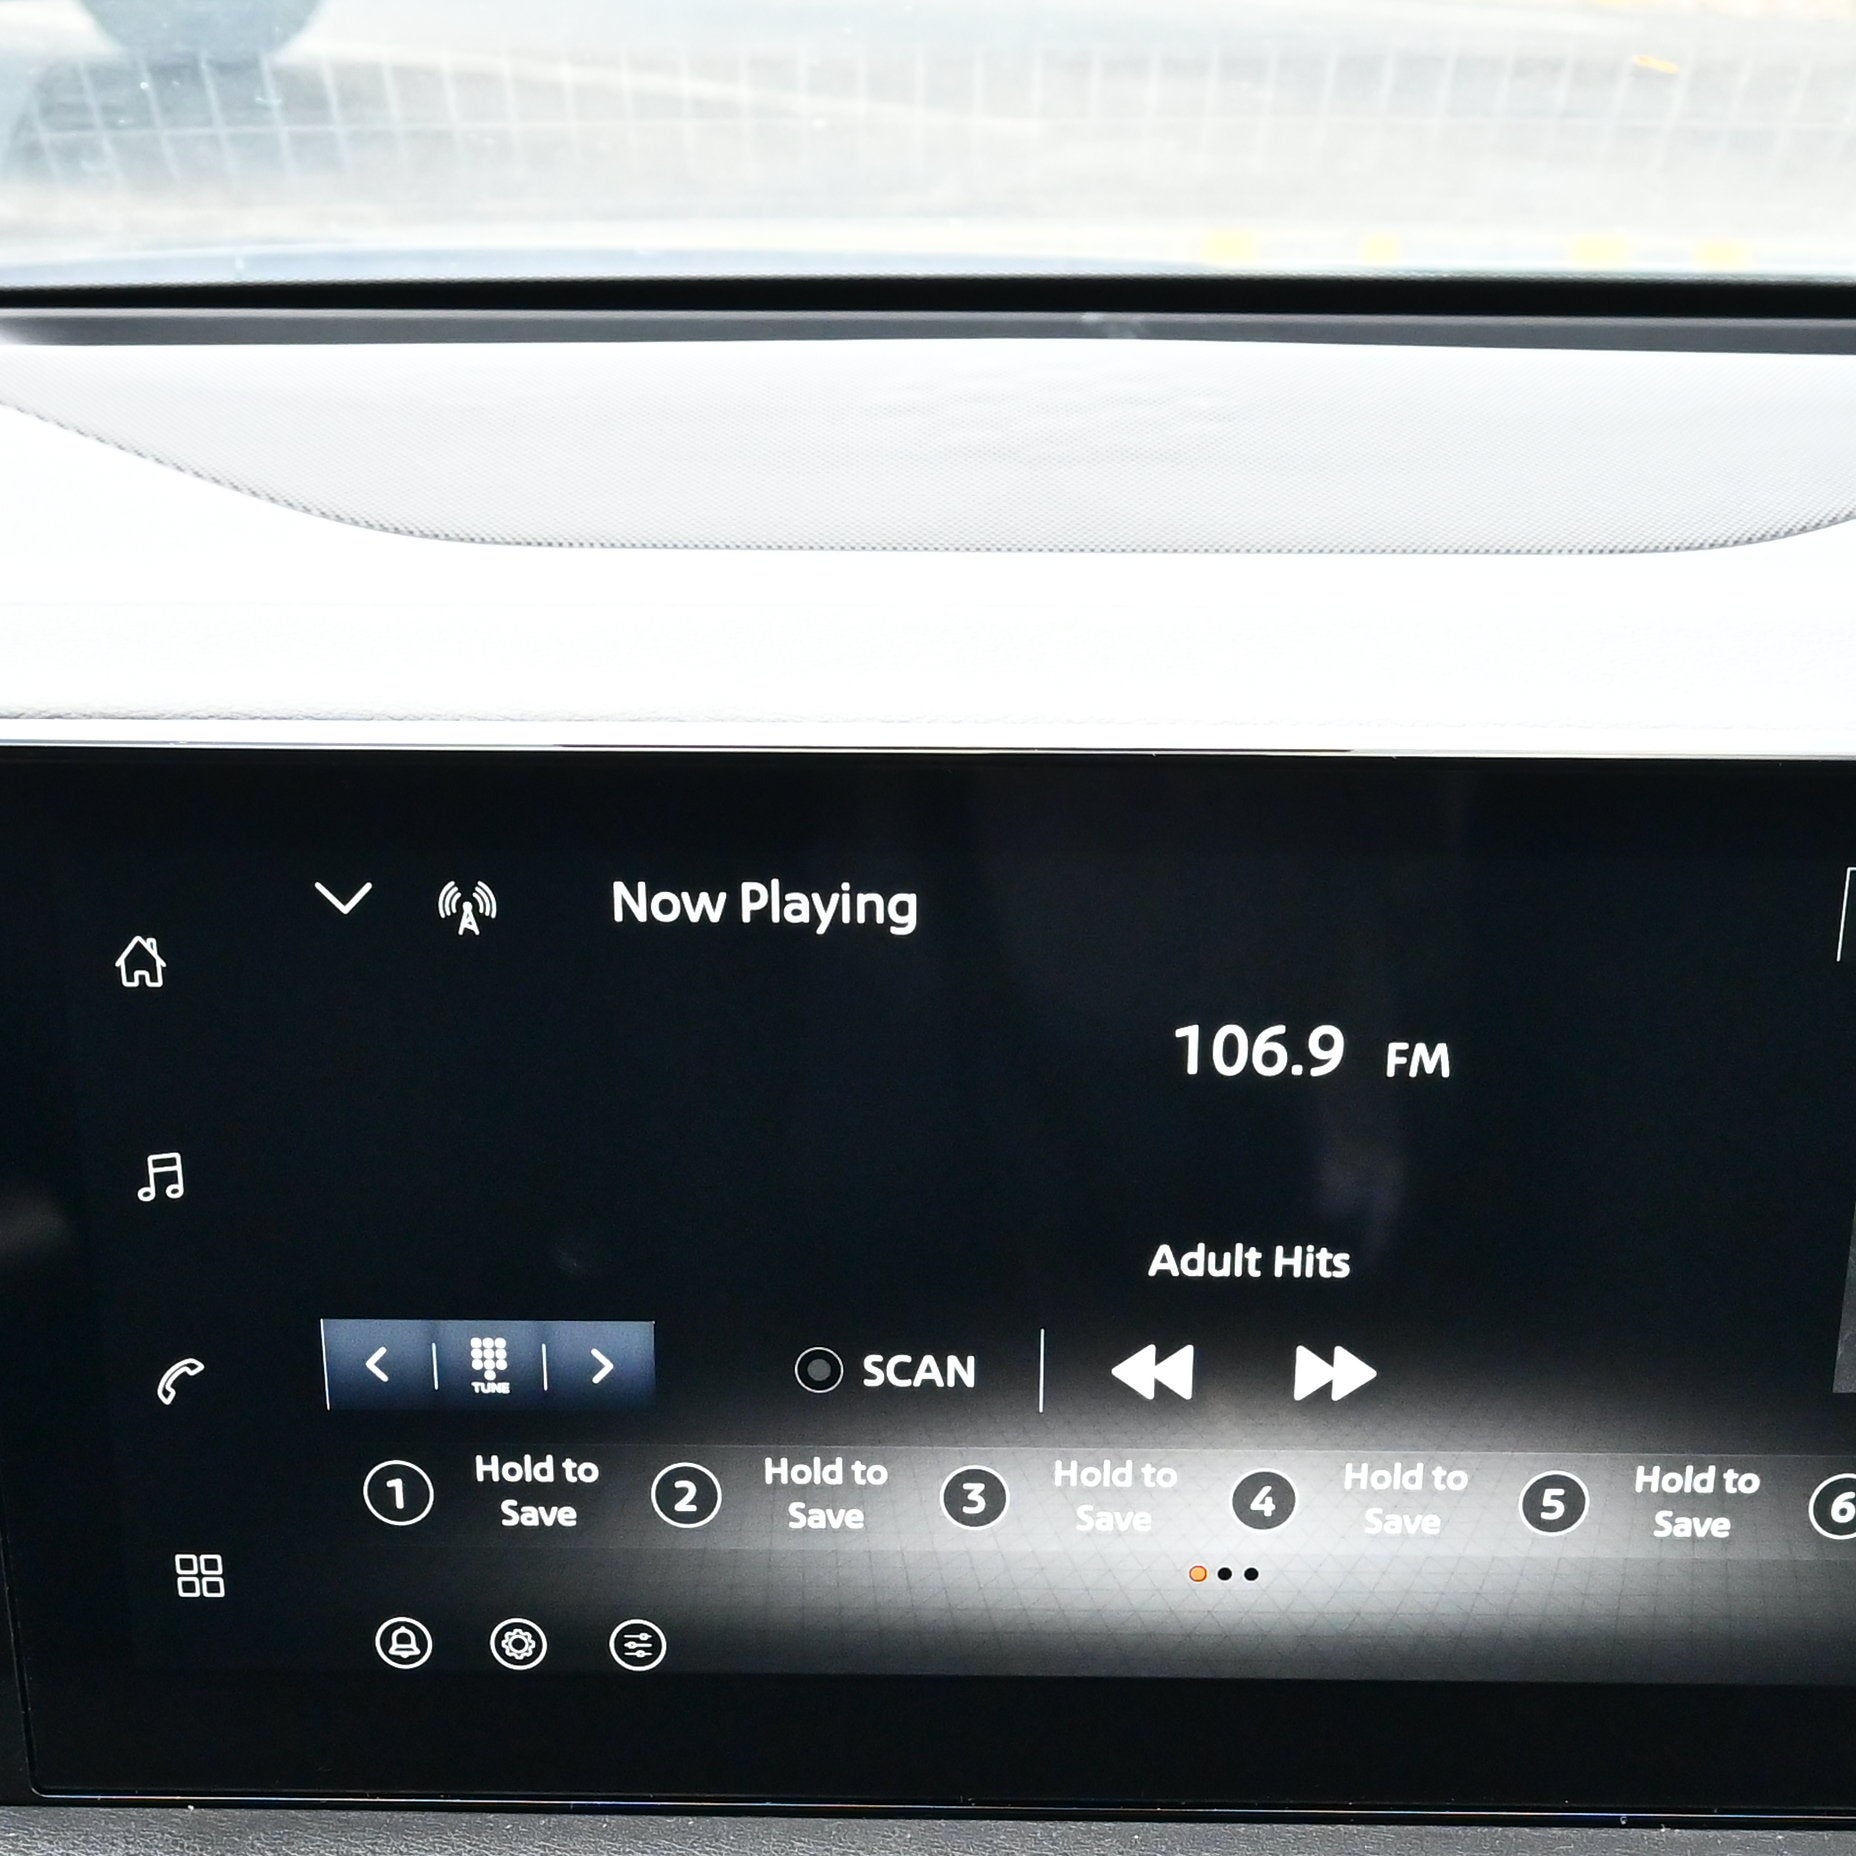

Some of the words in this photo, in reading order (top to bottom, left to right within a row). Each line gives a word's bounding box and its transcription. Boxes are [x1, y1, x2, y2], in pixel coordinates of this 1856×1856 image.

[613, 881, 726, 923] Now
[742, 878, 916, 935] Playing
[1175, 1024, 1344, 1076] 106.9
[1387, 1042, 1449, 1078] FM
[1148, 1243, 1262, 1277] Adult
[1274, 1245, 1350, 1278] Hits
[863, 1354, 975, 1389] SCAN
[471, 1381, 511, 1395] TUNE
[475, 1454, 554, 1483] Hold
[562, 1457, 599, 1483] to
[764, 1457, 843, 1485] Hold
[851, 1460, 889, 1485] to
[1053, 1460, 1133, 1488] Hold
[1141, 1462, 1178, 1488] to
[1344, 1462, 1423, 1490] Hold
[1431, 1465, 1469, 1491] to
[1635, 1465, 1715, 1494] Hold
[1723, 1468, 1760, 1494] to
[386, 1478, 405, 1509] 1
[674, 1480, 697, 1512] 2
[962, 1483, 986, 1514] 3
[1249, 1486, 1276, 1517] 4
[1540, 1488, 1565, 1520] 5
[1830, 1491, 1856, 1523] 6
[501, 1499, 577, 1527] Save
[787, 1502, 864, 1529] Save
[1076, 1505, 1152, 1532] Save
[1364, 1507, 1441, 1535] Save
[1653, 1510, 1731, 1538] Save
